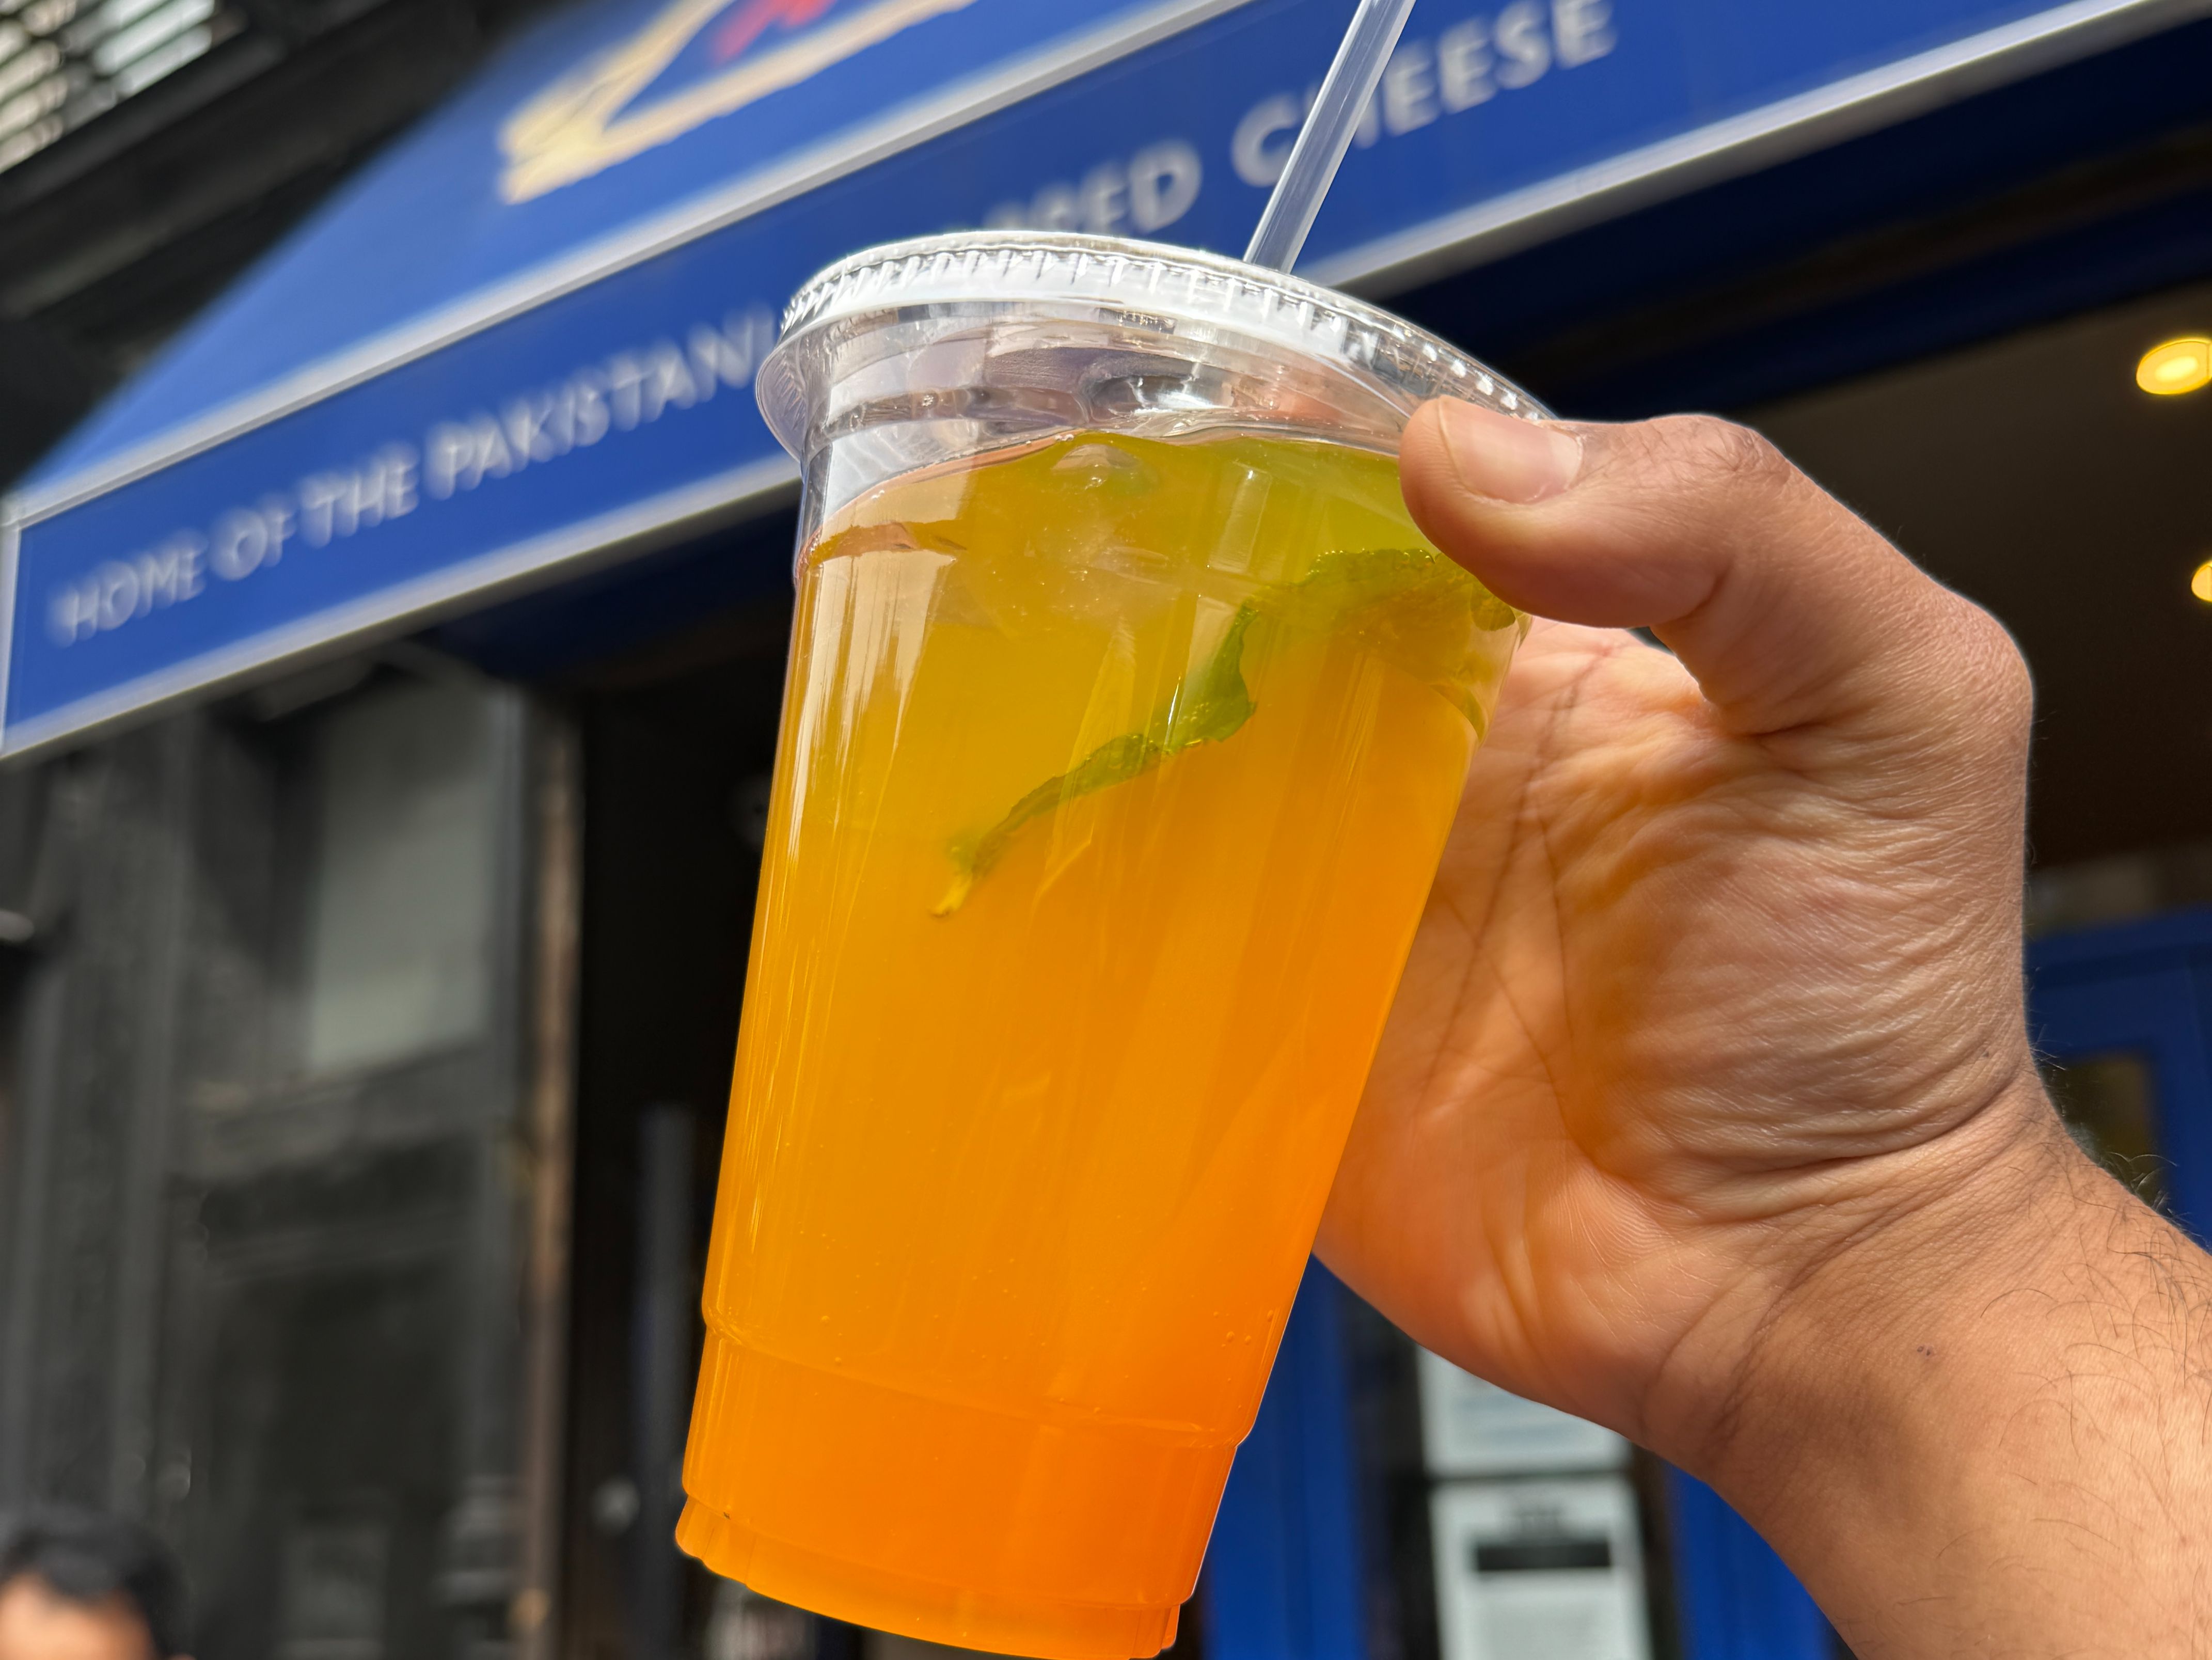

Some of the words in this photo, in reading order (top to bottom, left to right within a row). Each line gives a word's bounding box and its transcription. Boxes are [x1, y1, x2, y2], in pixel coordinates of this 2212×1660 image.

[46, 528, 208, 648] HOME
[209, 493, 297, 581] OF
[298, 440, 419, 548] THE
